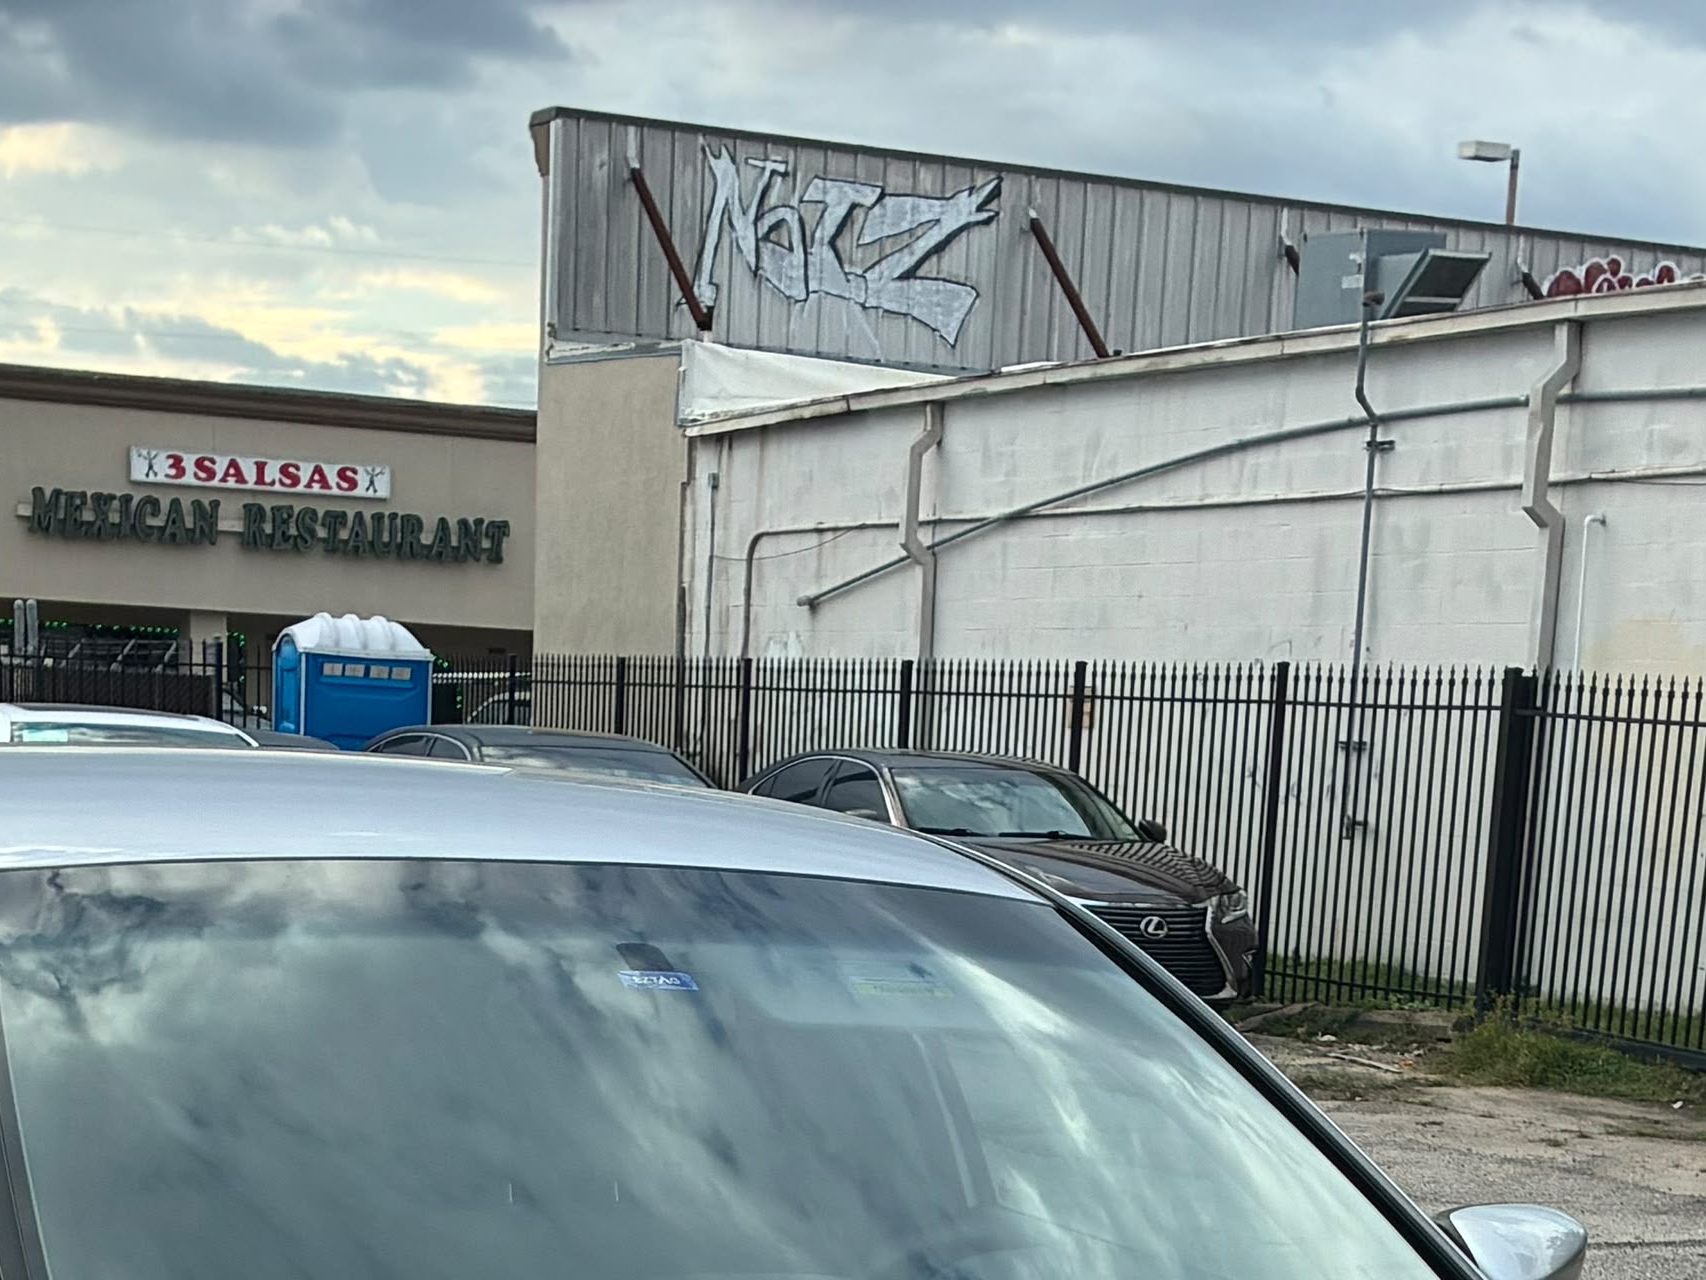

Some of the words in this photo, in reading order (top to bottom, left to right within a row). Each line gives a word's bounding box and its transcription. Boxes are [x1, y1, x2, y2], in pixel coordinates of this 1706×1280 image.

[193, 456, 359, 492] SALSAS
[28, 486, 221, 546] MEXICAN
[243, 502, 511, 564] RESTAURANT
